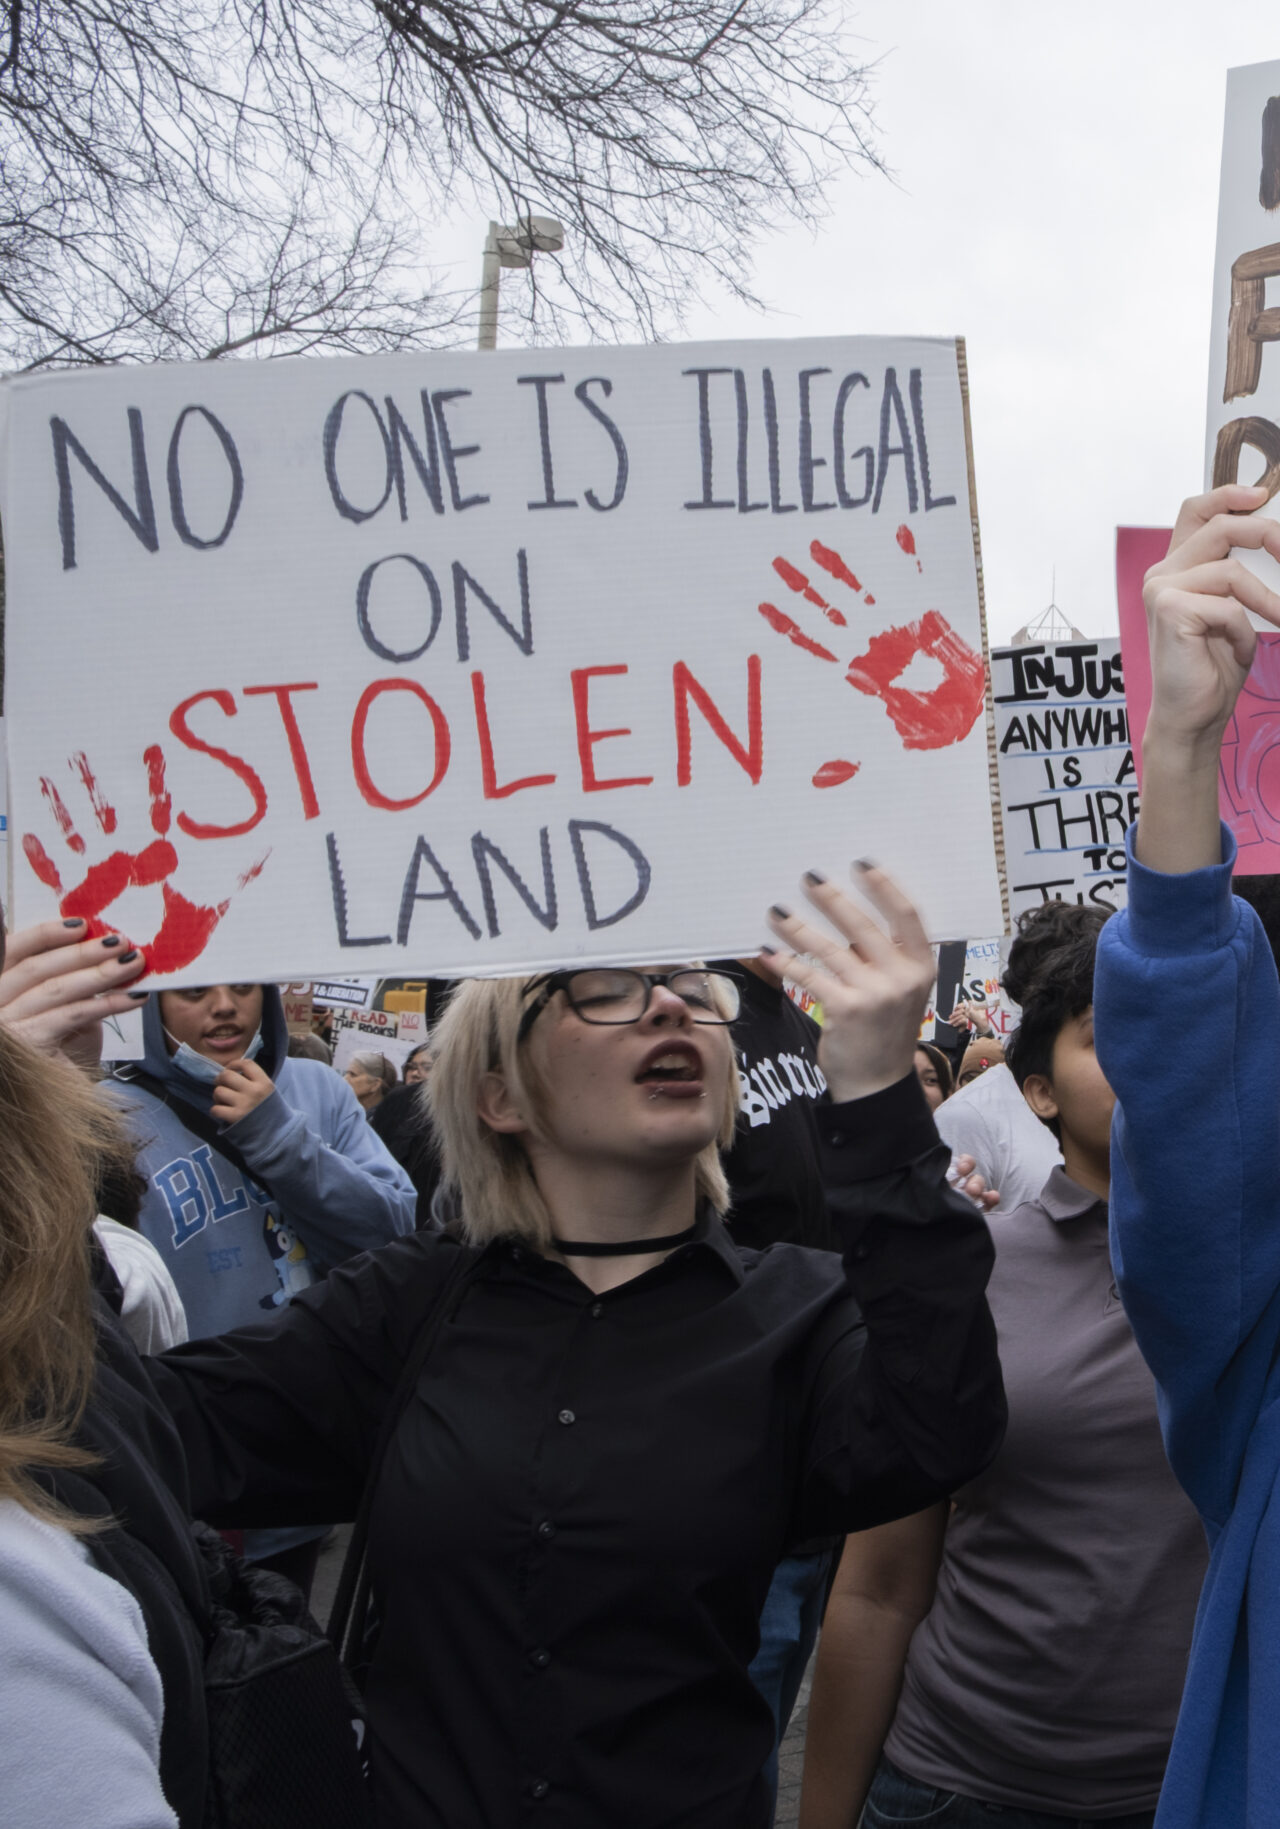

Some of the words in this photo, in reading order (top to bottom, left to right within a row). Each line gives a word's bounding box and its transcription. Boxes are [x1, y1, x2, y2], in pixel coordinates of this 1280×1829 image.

[50, 405, 243, 571] NO
[323, 389, 489, 523] ONE
[517, 373, 628, 511] IS
[682, 367, 956, 514] ILLEGAL
[357, 549, 534, 663] ON
[169, 654, 763, 839] STOLEN
[1000, 708, 1131, 754] ANYWH
[1044, 756, 1081, 789] IS
[326, 818, 651, 947] LAND
[1083, 848, 1127, 871] TO
[351, 1010, 387, 1026] READ
[207, 1247, 242, 1273] EST
